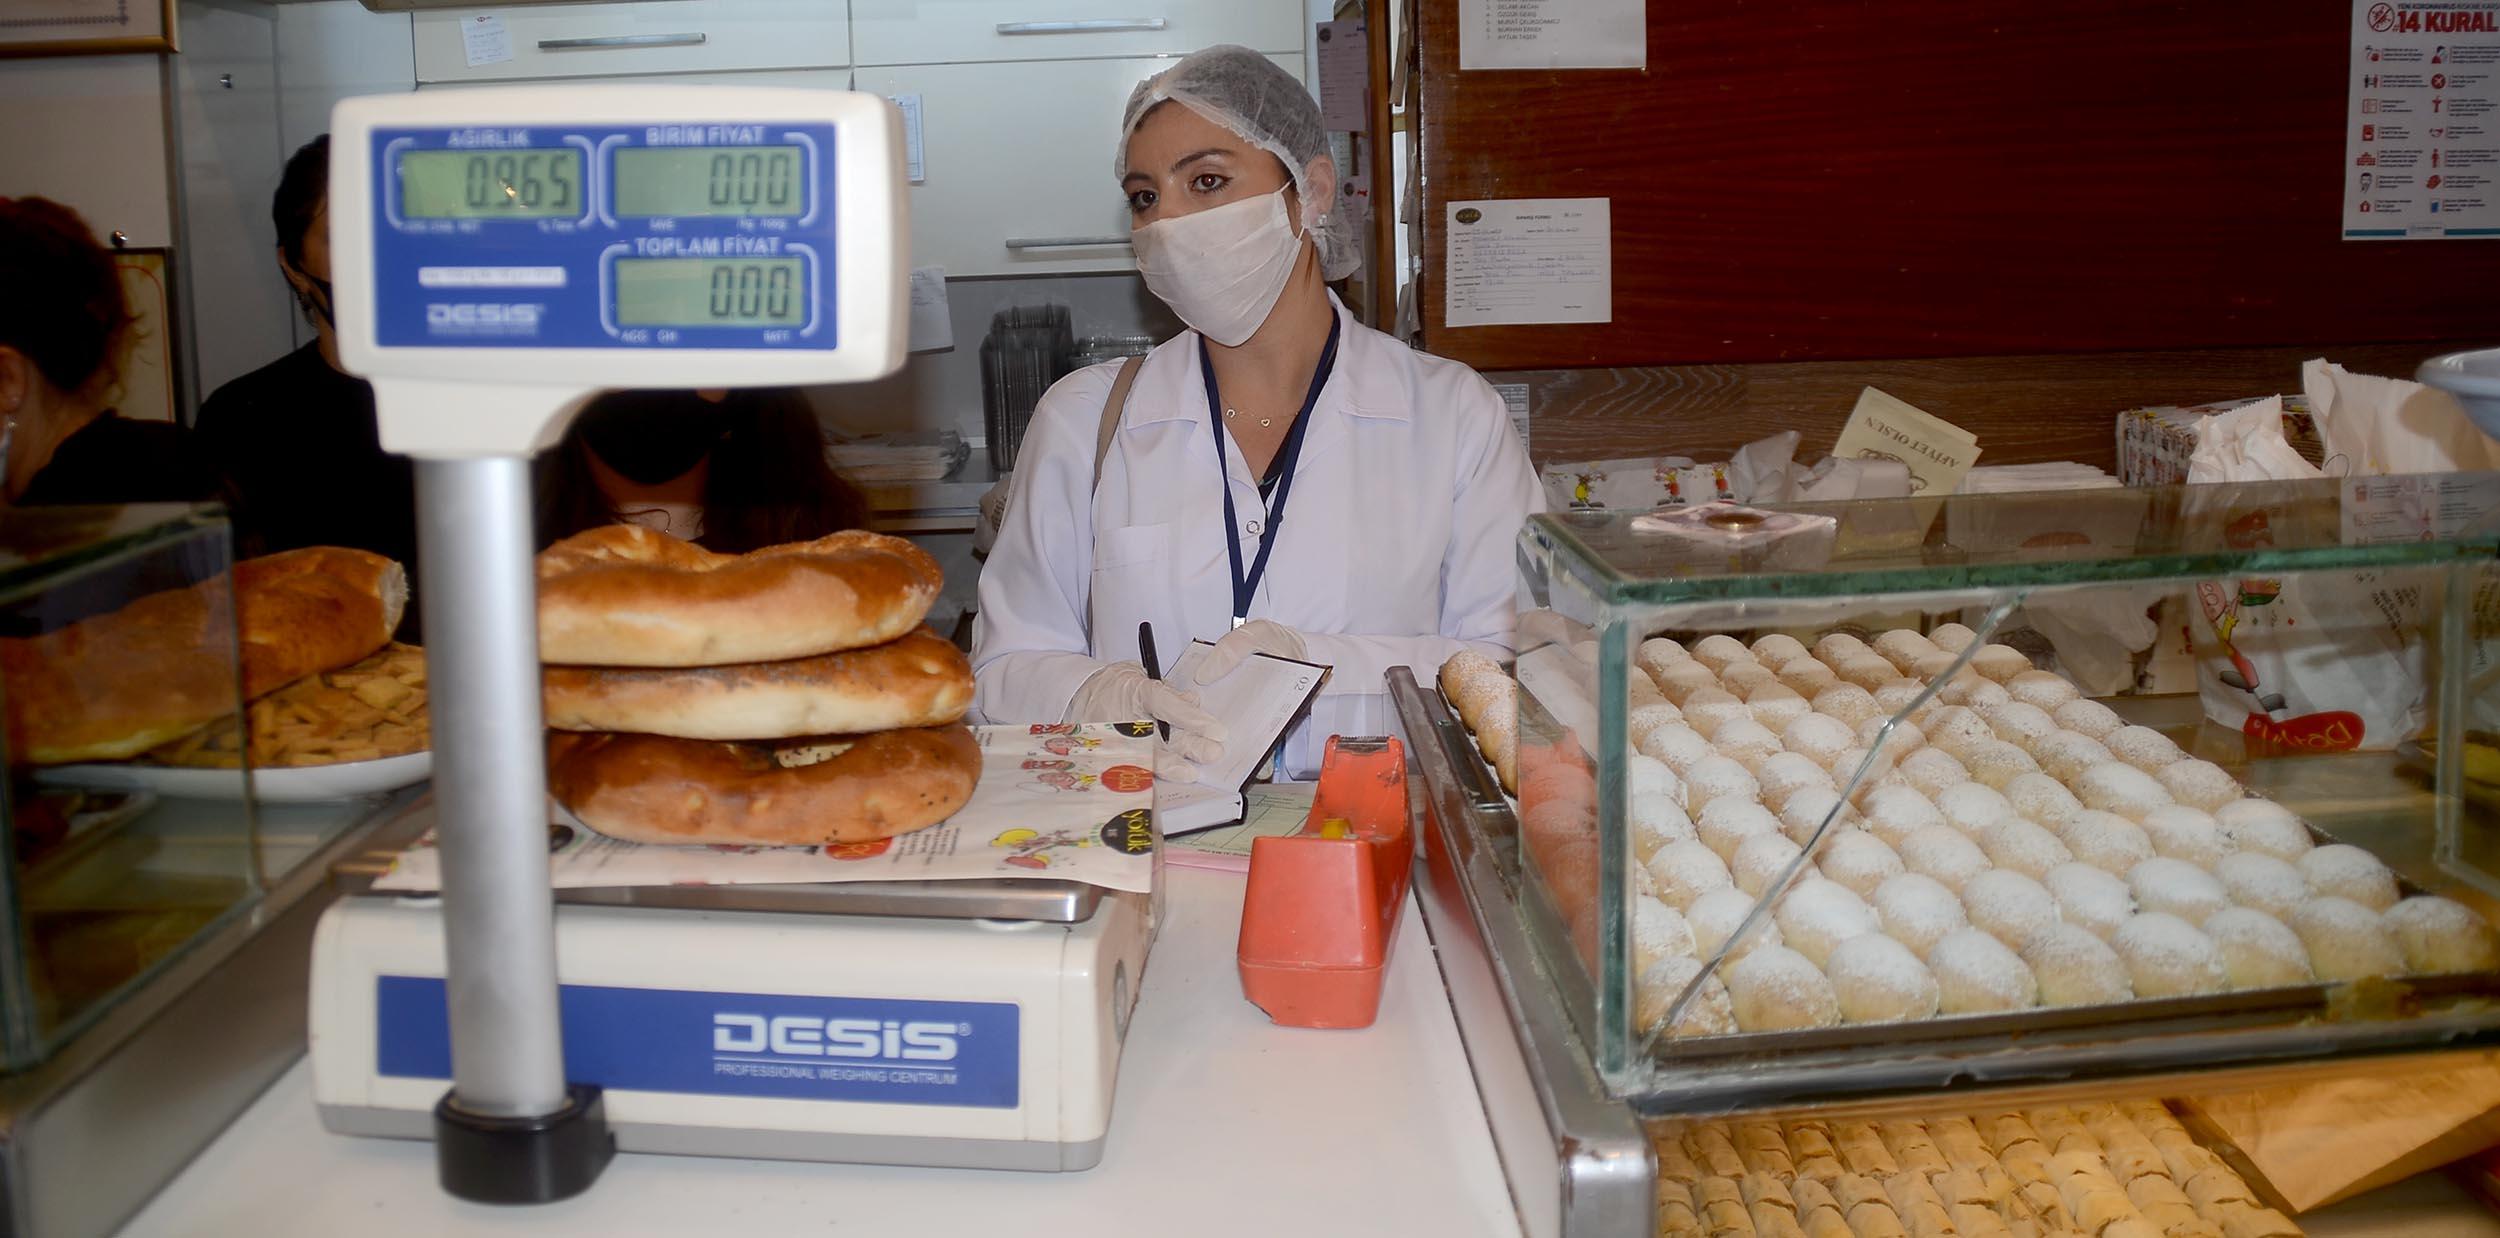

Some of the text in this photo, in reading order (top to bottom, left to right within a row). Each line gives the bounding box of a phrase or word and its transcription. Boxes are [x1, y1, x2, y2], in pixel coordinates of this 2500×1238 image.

[2425, 11, 2499, 33] KURAL
[708, 126, 766, 145] FİYAT
[635, 234, 780, 256] TOPLAM FİYAT
[1864, 416, 1910, 445] OLSUN
[714, 1063, 958, 1085] PROFESSIONAL WEIGHING CENTRUM
